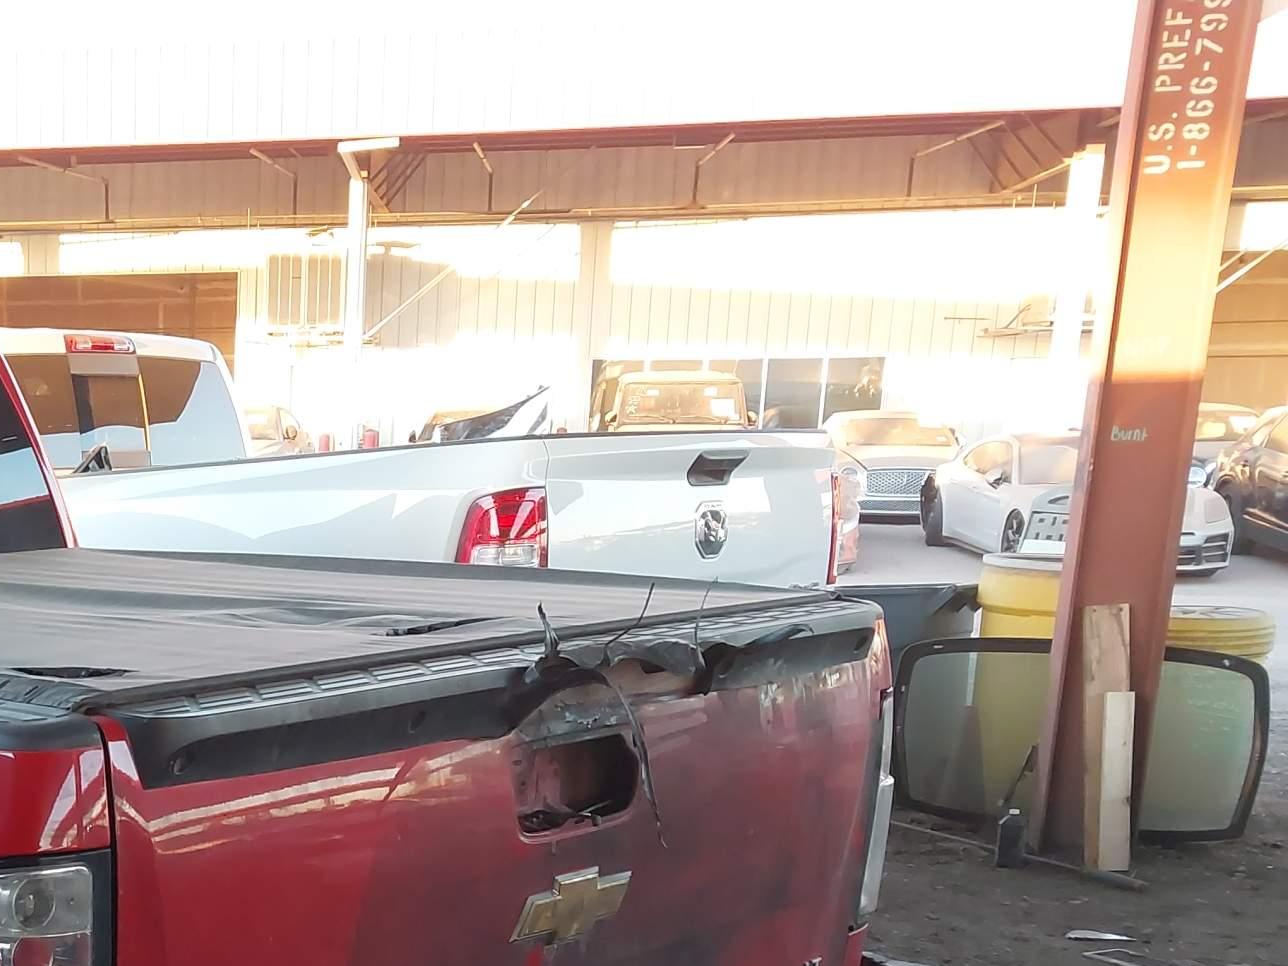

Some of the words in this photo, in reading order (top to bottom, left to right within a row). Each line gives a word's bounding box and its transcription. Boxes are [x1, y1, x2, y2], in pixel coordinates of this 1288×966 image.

[1154, 0, 1192, 92] PREF
[1143, 112, 1178, 174] U.S.
[1110, 424, 1149, 441] Burnt
